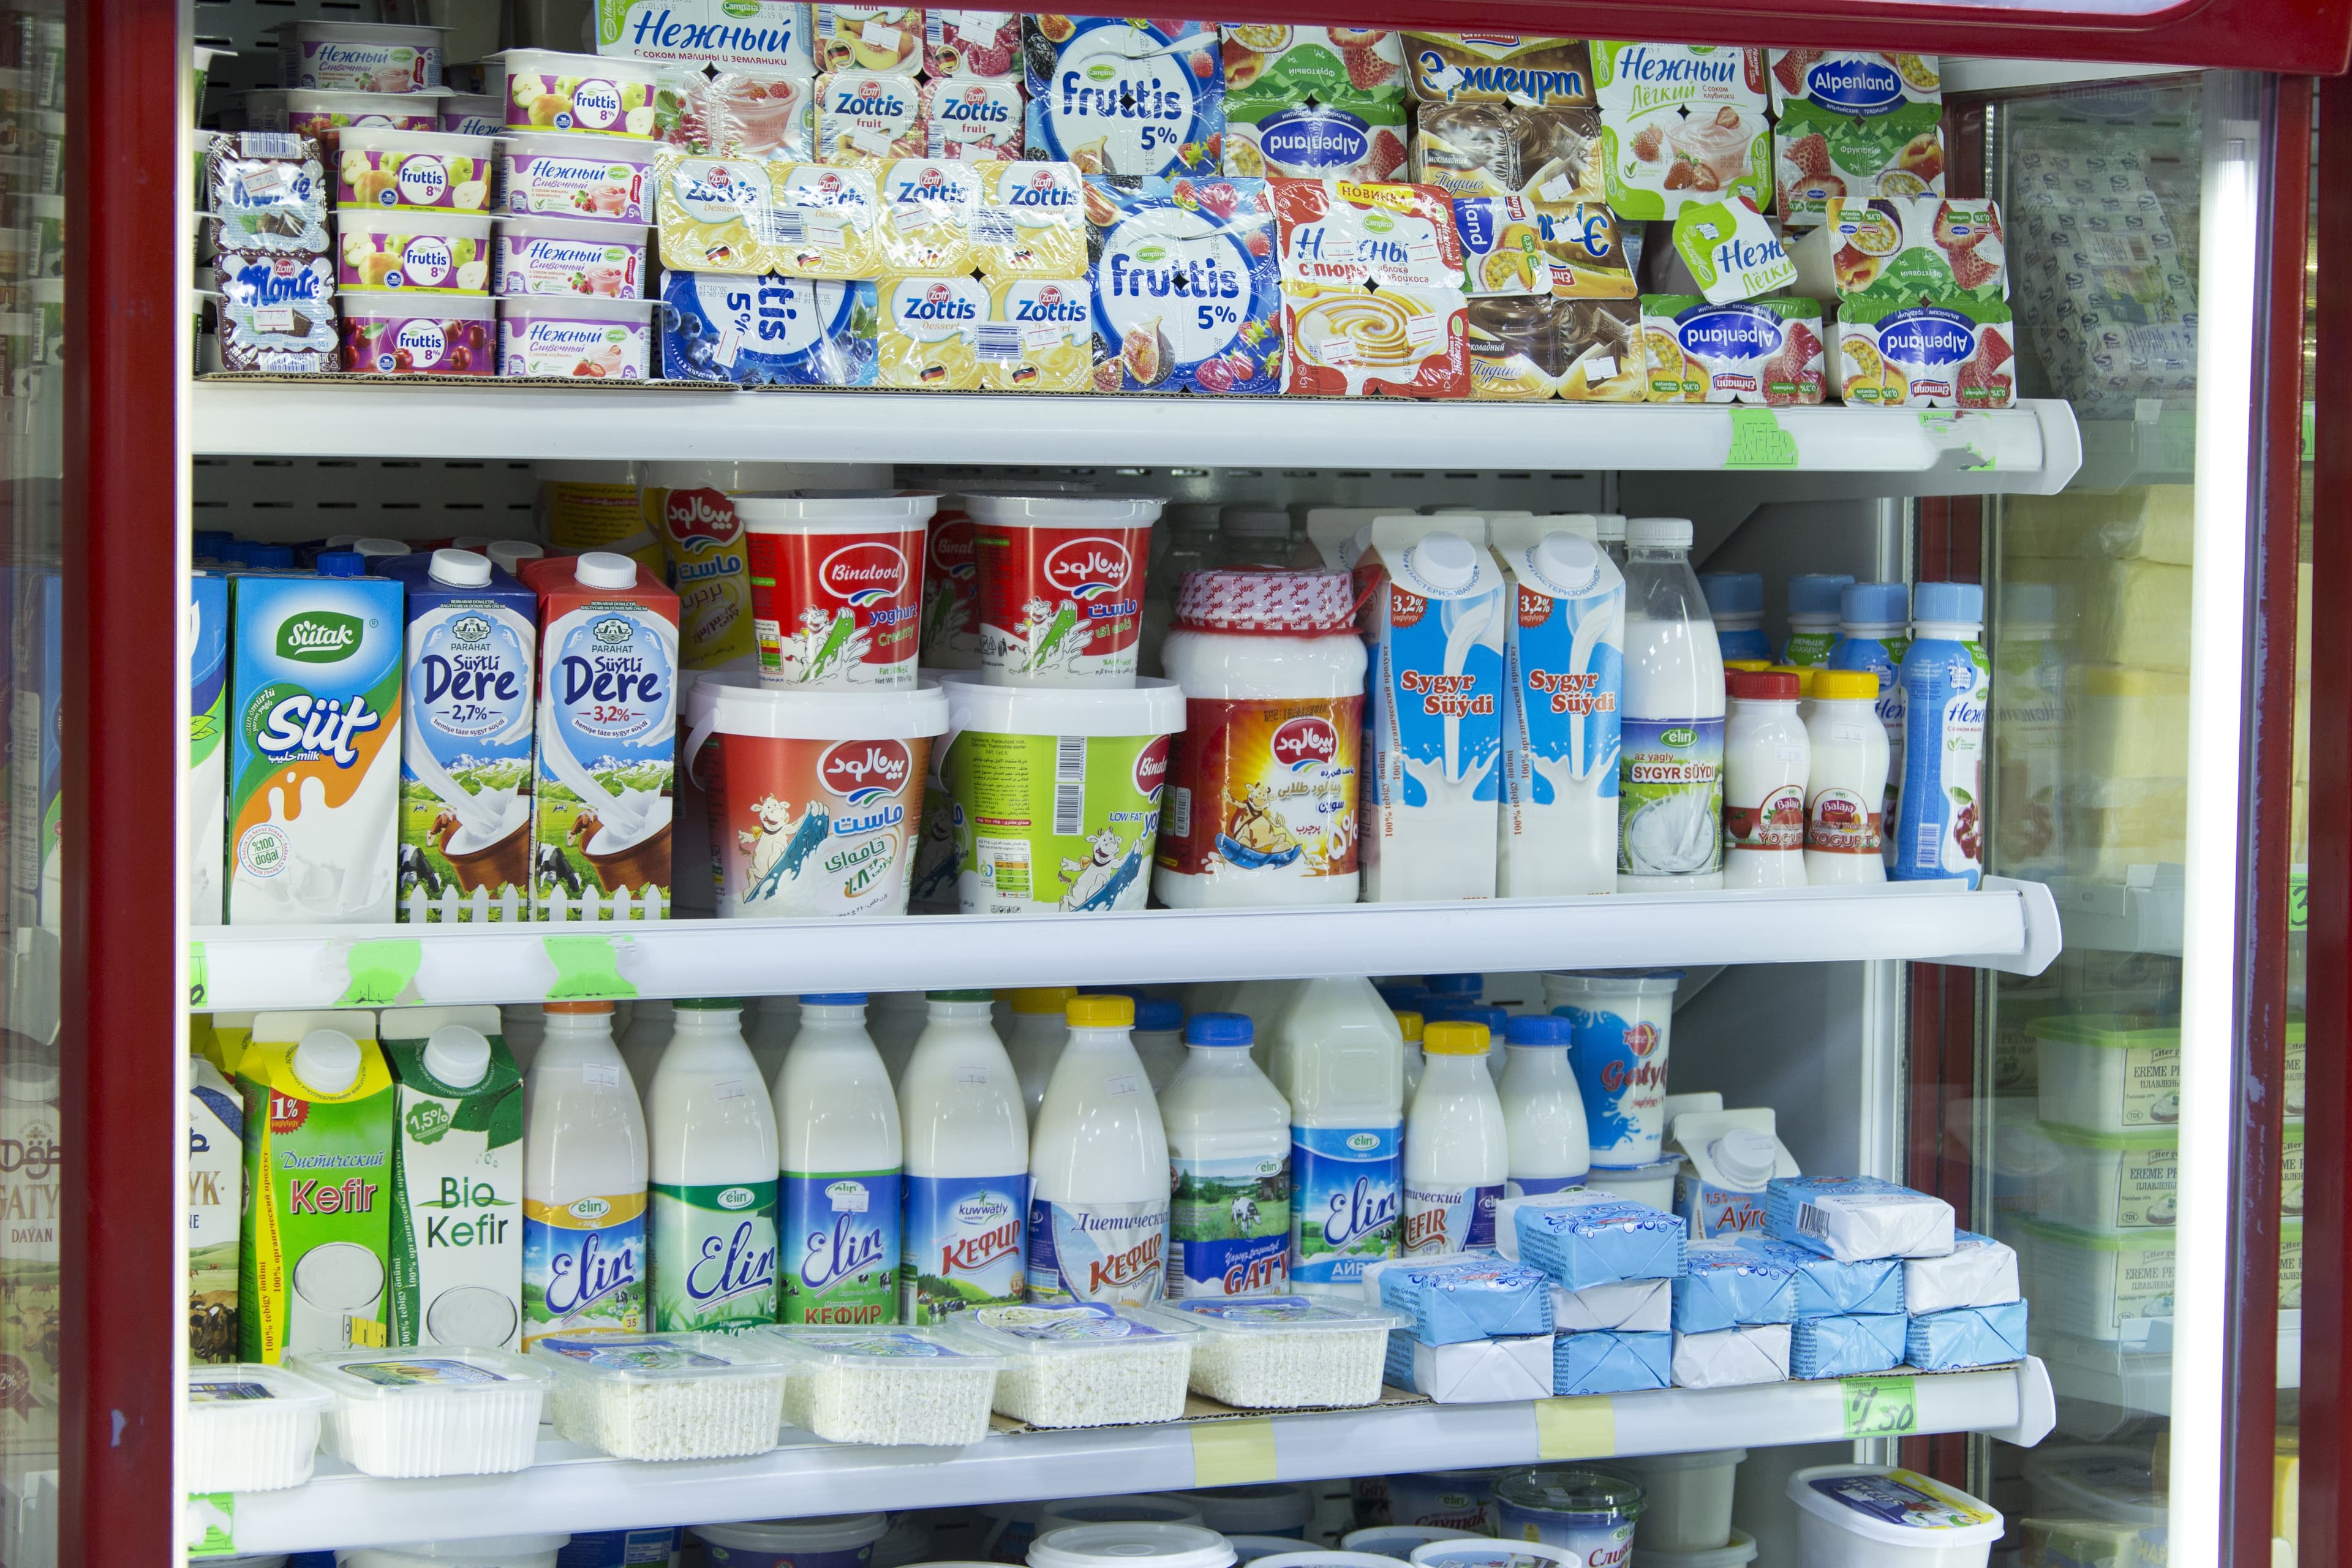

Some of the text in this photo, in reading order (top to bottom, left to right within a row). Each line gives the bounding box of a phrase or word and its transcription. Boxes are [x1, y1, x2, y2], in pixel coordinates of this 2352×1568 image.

[633, 9, 791, 53] Нежный
[319, 45, 389, 64] Нежный
[643, 51, 675, 59] соком
[679, 52, 720, 61] малины
[731, 56, 786, 66] земляники
[1289, 67, 1335, 77] Фруктовый
[1620, 47, 1735, 83] Нежный
[861, 84, 879, 96] Zott
[1815, 72, 1894, 93] Alpenland
[576, 92, 616, 109] fruttis
[835, 93, 903, 116] Zottis
[967, 90, 985, 102] Zott
[1062, 71, 1182, 119] fruttis
[1627, 80, 1695, 114] Лёгкий
[600, 110, 615, 121] 8%
[941, 99, 1008, 123] Zottis
[857, 118, 881, 128] fruit
[962, 124, 987, 134] fruit
[1141, 126, 1177, 150] 5%
[1270, 133, 1360, 155] Alpenland
[1428, 155, 1468, 165] шоколадный
[402, 164, 445, 185] fruttis
[532, 160, 606, 181] Нежный
[709, 172, 728, 183] Zott
[922, 172, 941, 184] Zott
[426, 185, 442, 196] 8%
[532, 177, 588, 189] Сливочный
[820, 177, 840, 190] Zott
[1034, 176, 1052, 189] Zott
[1432, 171, 1484, 194] Пудинг
[897, 182, 968, 203] Zottis
[1009, 185, 1078, 206] Zottis
[1342, 186, 1407, 205] НОВИНКА
[628, 208, 641, 218] 5%
[1364, 218, 1393, 229] Campina
[406, 247, 448, 266] fruttis
[530, 242, 603, 263] Нежный
[276, 262, 294, 274] Zott
[431, 266, 446, 277] 8%
[529, 258, 586, 271] Сливочный
[1299, 263, 1309, 275] с
[1111, 253, 1239, 298] fruttis
[622, 289, 635, 298] 5%
[930, 290, 948, 301] Zott
[1041, 292, 1060, 303] Zott
[904, 298, 976, 320] Zottis
[1016, 300, 1087, 322] Zottis
[1198, 305, 1237, 330] 5%
[530, 324, 603, 343] Нежный
[922, 322, 960, 331] Dessert
[399, 330, 442, 349] fruttis
[529, 342, 586, 353] Сливочный
[1687, 329, 1774, 347] Alpenland
[1887, 331, 1968, 353] Alpenland
[424, 349, 440, 360] 8%
[624, 369, 636, 378] 5%
[1683, 382, 1700, 391] 0,3%
[1716, 378, 1755, 390] Ehrmann
[1913, 383, 1950, 395] Ehrmann
[677, 554, 742, 579] ماست
[832, 564, 900, 581] Binalood
[1088, 598, 1137, 619] ماست
[1393, 595, 1423, 614] 3,2%
[1520, 595, 1550, 614] 3,2%
[870, 602, 918, 627] yoghurt
[287, 620, 354, 648] Sütak
[878, 625, 914, 647] Creamy
[592, 644, 633, 653] PARAHAT
[421, 654, 519, 704] Dere
[562, 655, 662, 706] Dere
[1401, 670, 1476, 694] Sygyr
[1529, 669, 1598, 693] Sygyr
[249, 688, 276, 716] ömürlü
[1424, 695, 1493, 717] Süýdi
[1552, 693, 1615, 717] Süýdi
[452, 705, 487, 721] 2,7%
[594, 706, 630, 722] 3,2%
[257, 695, 380, 768] Süt
[470, 727, 488, 737] sygyr
[611, 728, 630, 738] sygyr
[296, 750, 320, 761] milk
[1647, 752, 1674, 763] ýagly
[1634, 766, 1681, 780] SYGYR
[1109, 812, 1143, 822] LOW FAT
[1823, 800, 1855, 815] Balaja
[834, 805, 903, 835] ماست
[252, 837, 274, 852] %100
[255, 850, 279, 865] doğal
[2134, 1066, 2167, 1078] EREME
[271, 1097, 298, 1120] 1%
[409, 1108, 448, 1131] 1,5%
[280, 1150, 385, 1169] Диетический
[2130, 1167, 2163, 1180] EREME
[292, 1177, 378, 1214] Kefir
[441, 1177, 495, 1208] Bio
[1705, 1193, 1728, 1204] 1,5%
[959, 1201, 1008, 1216] kuwwatly
[1324, 1175, 1396, 1246] Elin
[11, 1226, 53, 1243] DAÝAN
[266, 1194, 281, 1262] органический
[428, 1213, 508, 1248] Kefir
[801, 1212, 883, 1288] Elin
[941, 1219, 1021, 1277] КЕФИР
[686, 1221, 775, 1300] Elin
[1088, 1232, 1162, 1294] КЕФИР
[546, 1232, 634, 1314] Elin
[2125, 1268, 2159, 1280] EREME
[260, 1294, 271, 1322] tebigy
[805, 1305, 882, 1324] КЕФИР
[1846, 1381, 1871, 1390] Bahasy
